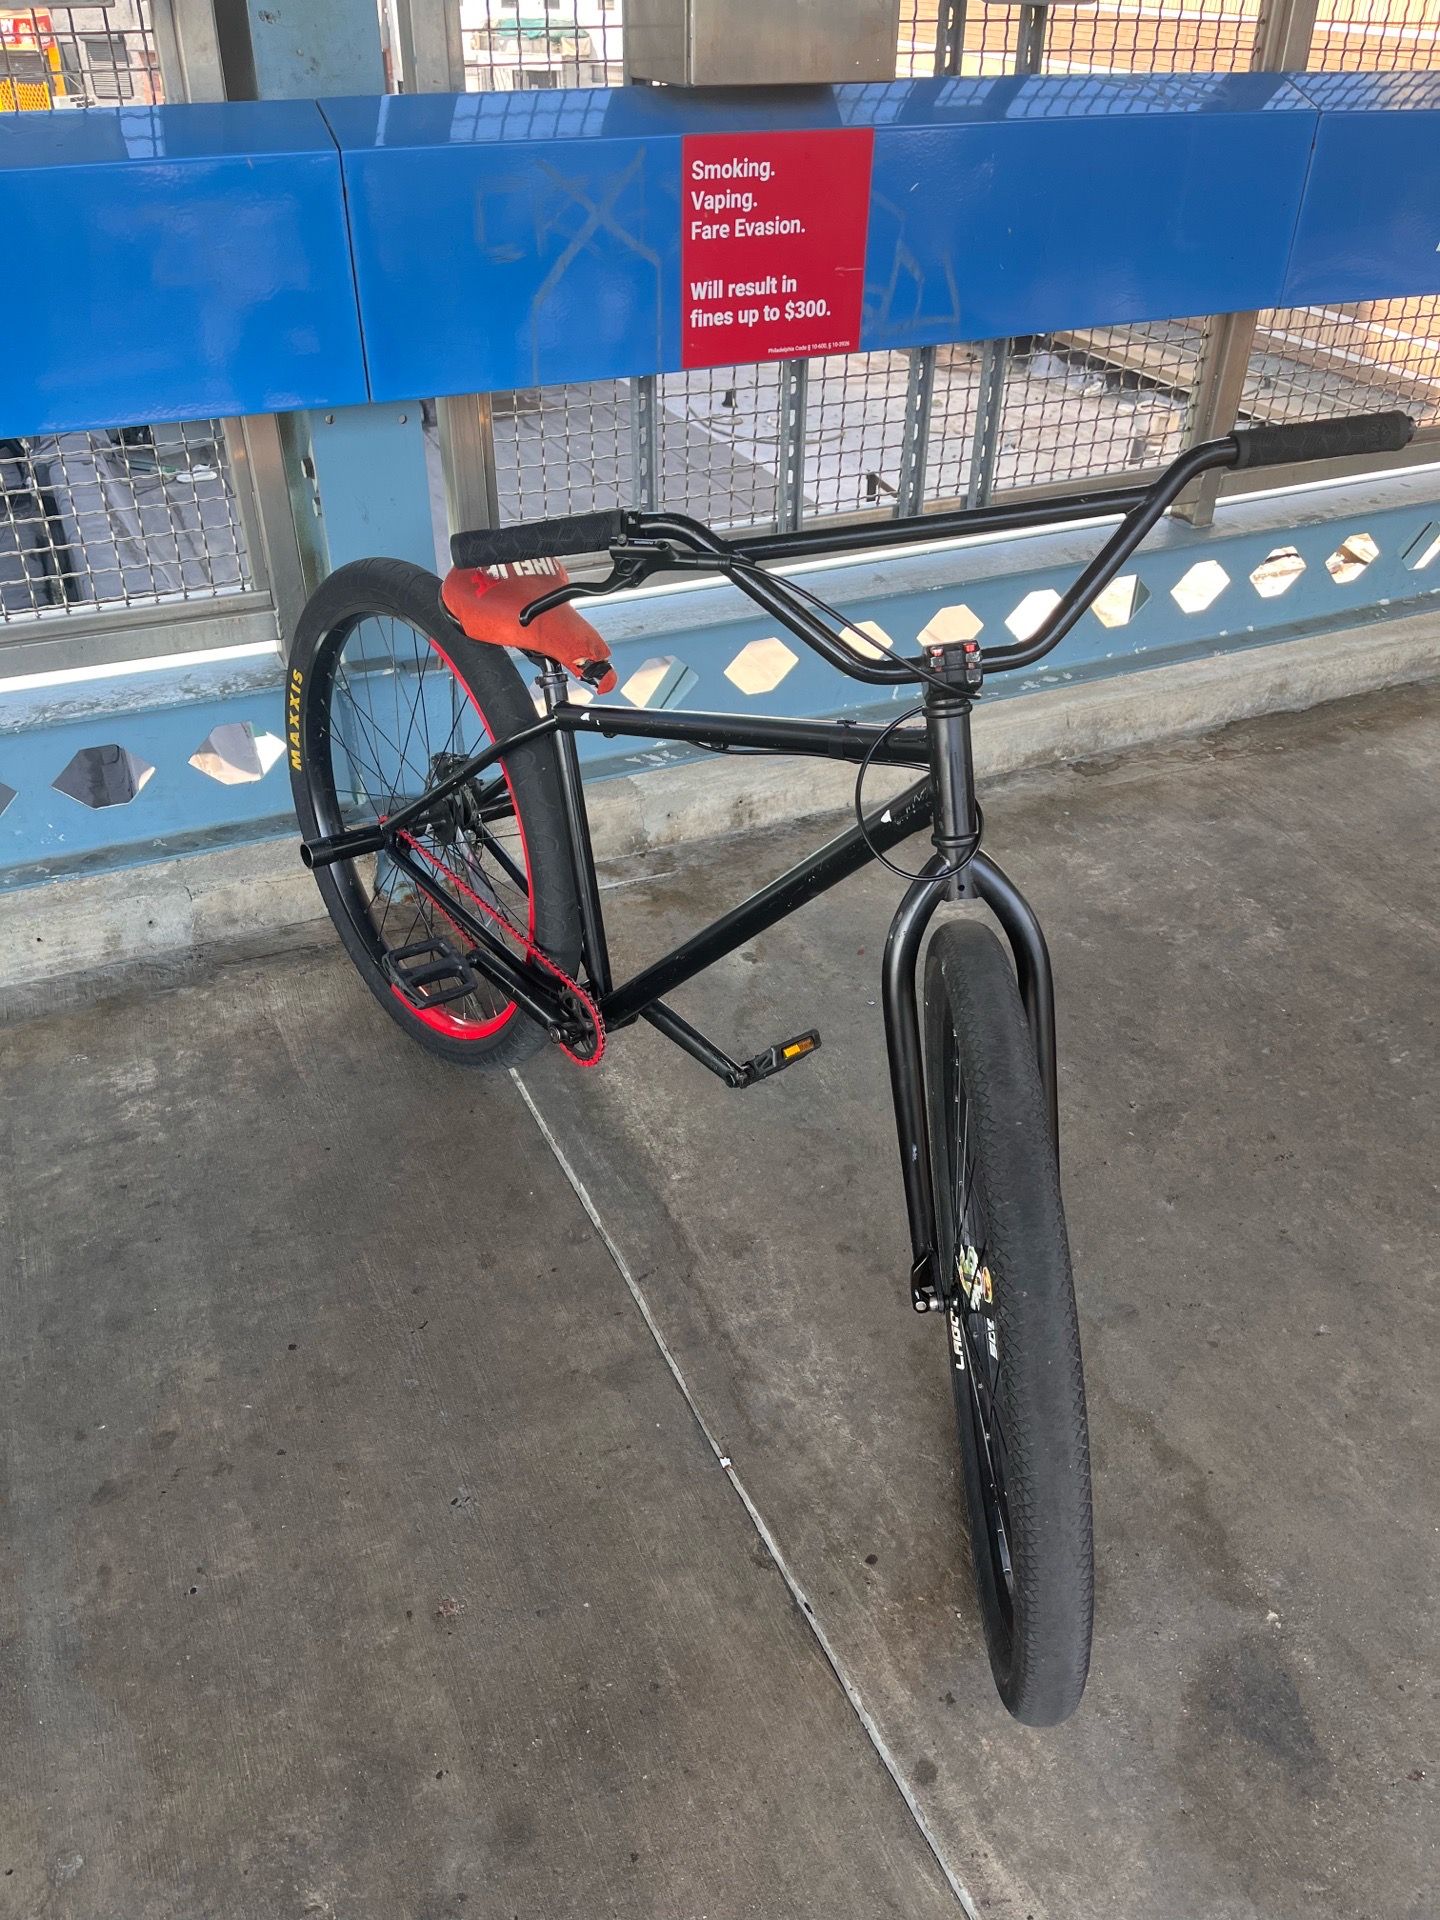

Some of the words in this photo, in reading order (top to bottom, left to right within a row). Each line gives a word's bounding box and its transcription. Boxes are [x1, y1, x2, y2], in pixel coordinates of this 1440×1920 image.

[691, 157, 776, 182] Smoking.
[691, 188, 758, 214] Vaping.
[691, 220, 731, 241] Fare
[734, 215, 806, 238] Evasion.
[690, 279, 724, 301] Will
[727, 275, 778, 298] result
[781, 274, 797, 293] in
[690, 308, 734, 328] fines
[737, 308, 760, 328] up
[762, 304, 780, 322] to
[784, 298, 831, 322] $300.
[289, 668, 303, 771] MAXXIS
